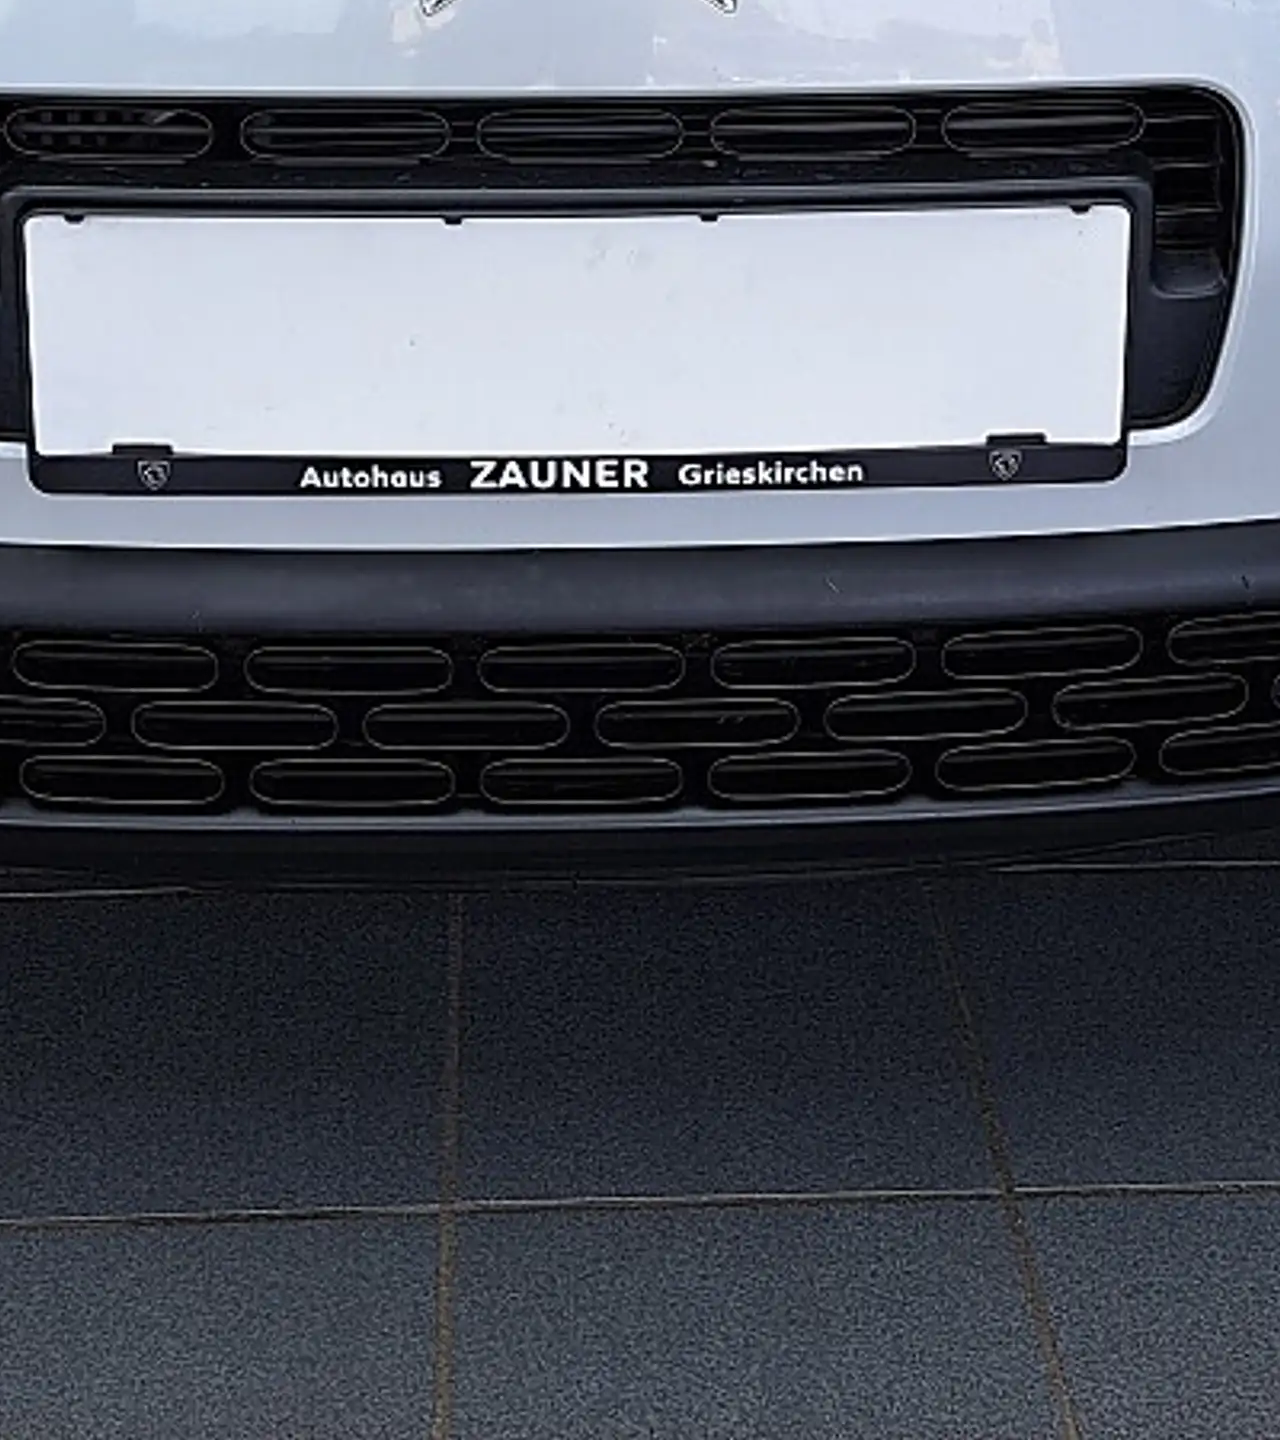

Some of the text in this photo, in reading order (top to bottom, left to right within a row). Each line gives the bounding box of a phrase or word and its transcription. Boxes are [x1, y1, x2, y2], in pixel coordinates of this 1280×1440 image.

[299, 459, 864, 490] Autohaus ZAUNER Grieskirchen
